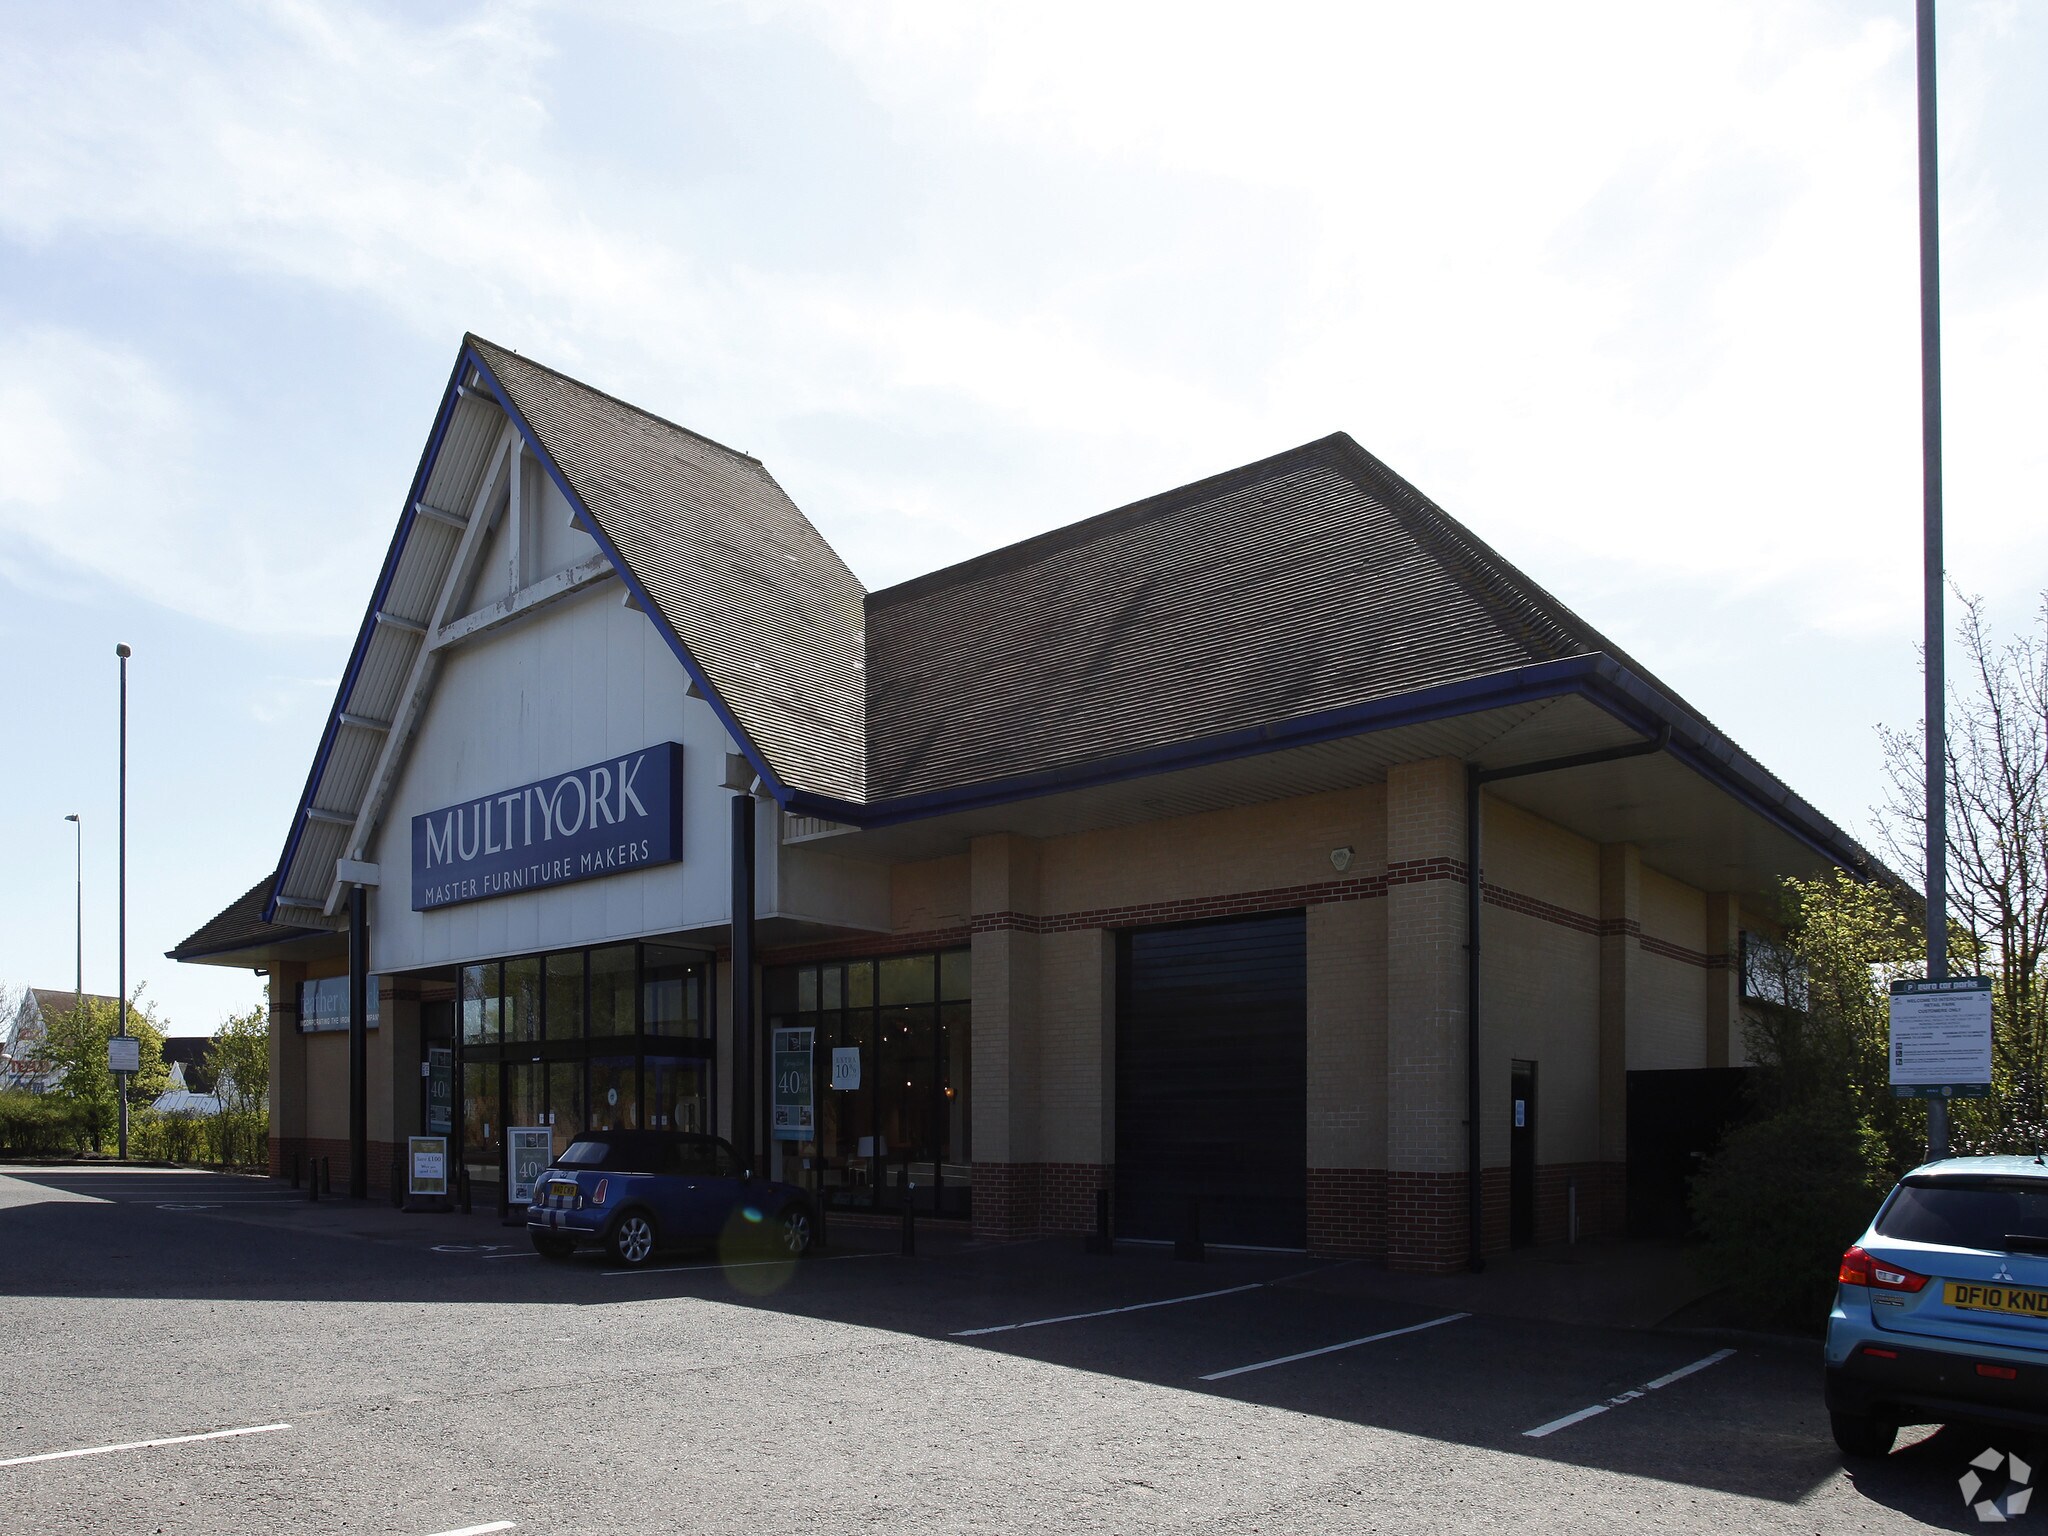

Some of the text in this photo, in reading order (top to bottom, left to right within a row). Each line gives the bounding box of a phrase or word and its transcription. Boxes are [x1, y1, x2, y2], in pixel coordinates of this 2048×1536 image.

[425, 754, 648, 869] MULTIYORK
[425, 839, 649, 905] MASTER FURNITURE MAKERS
[1953, 980, 1978, 990] parks
[1955, 1285, 2048, 1312] DF10 KND
